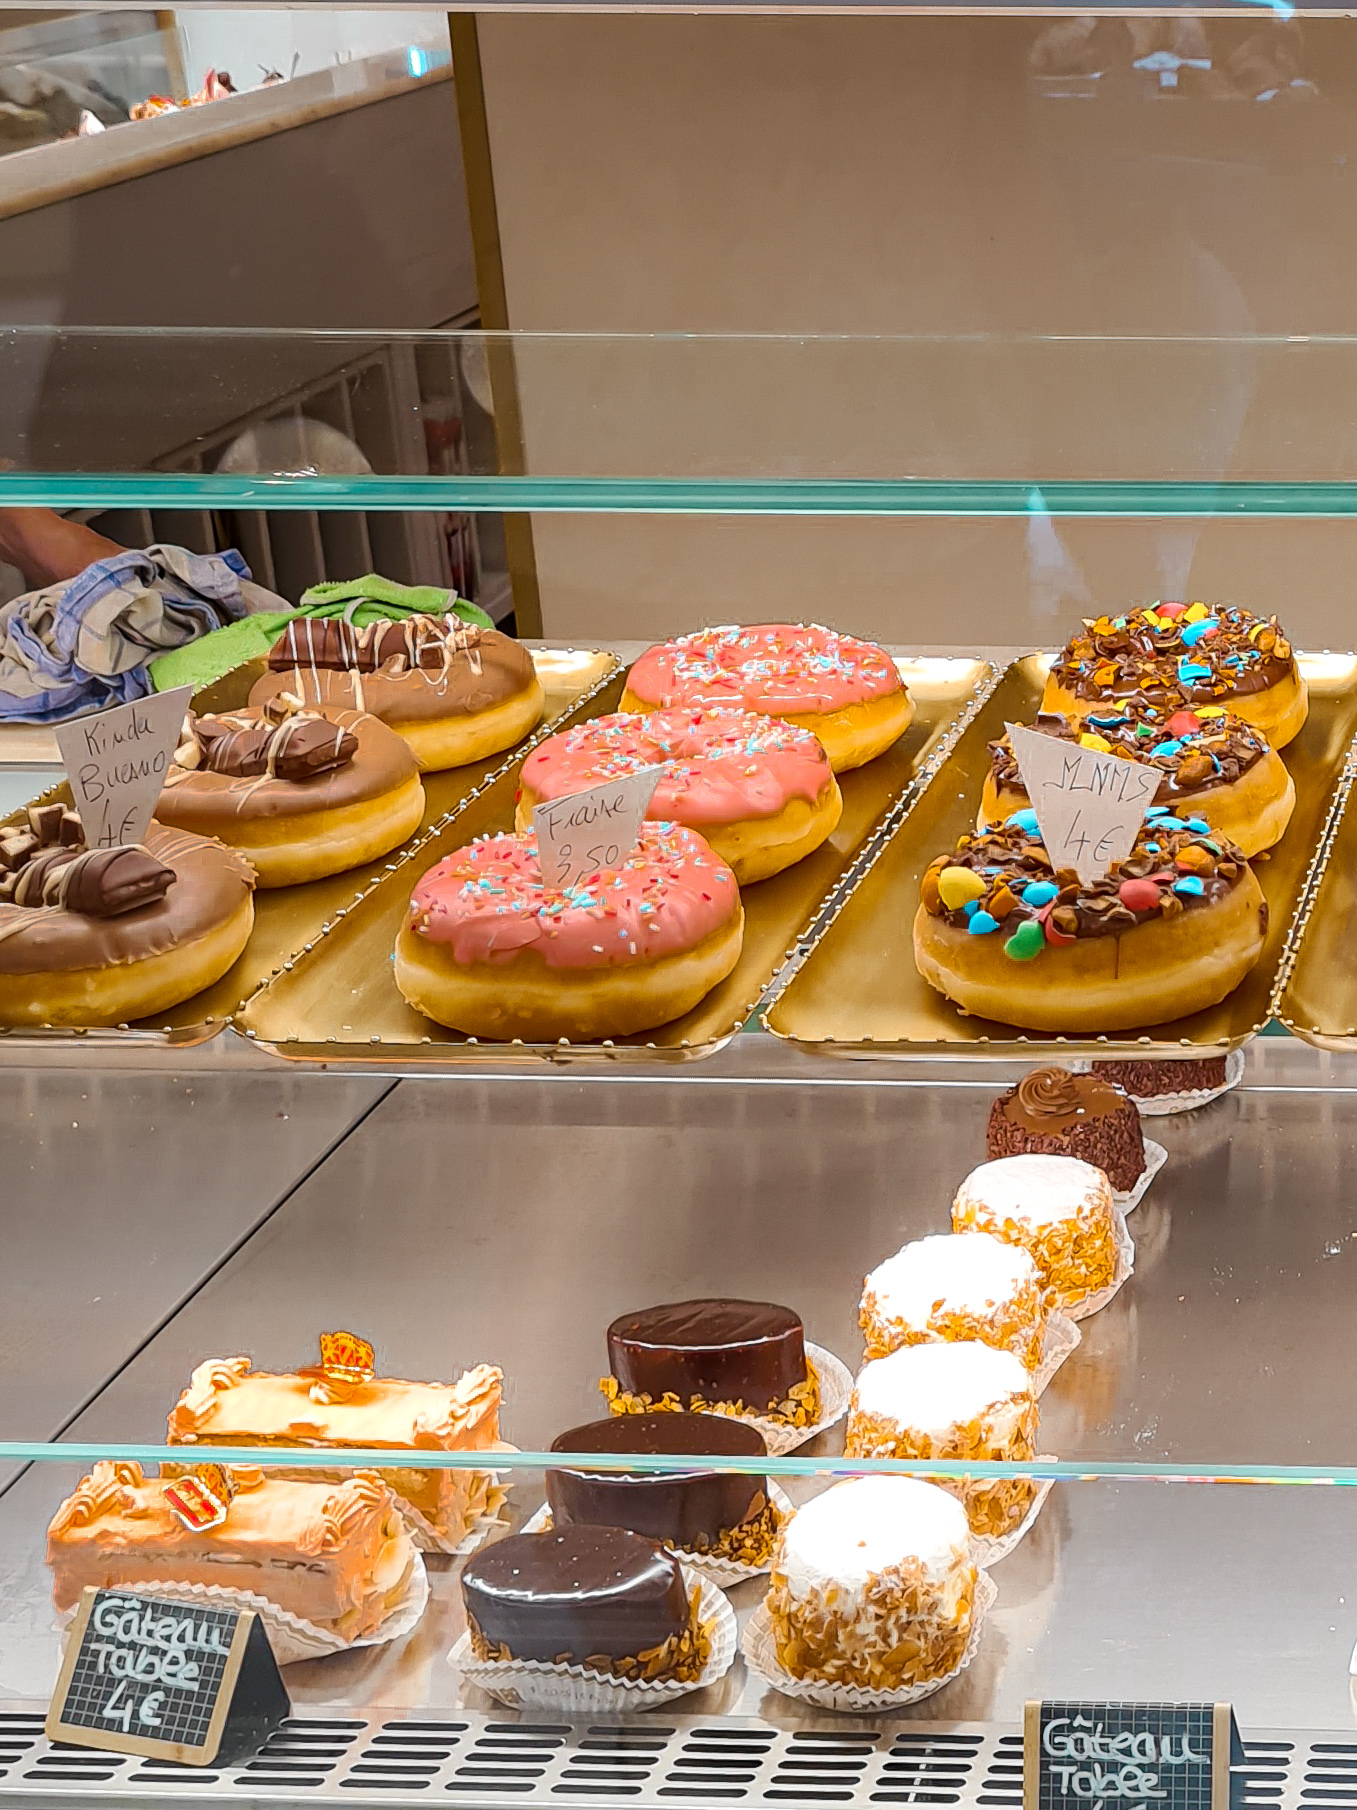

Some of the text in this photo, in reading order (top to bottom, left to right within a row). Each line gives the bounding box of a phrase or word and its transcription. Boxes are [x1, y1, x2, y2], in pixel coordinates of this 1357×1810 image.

[538, 795, 628, 840] Fraise
[557, 844, 619, 887] 3,50
[94, 1597, 232, 1657] Gâteau
[1043, 1714, 1210, 1765] Gâteau
